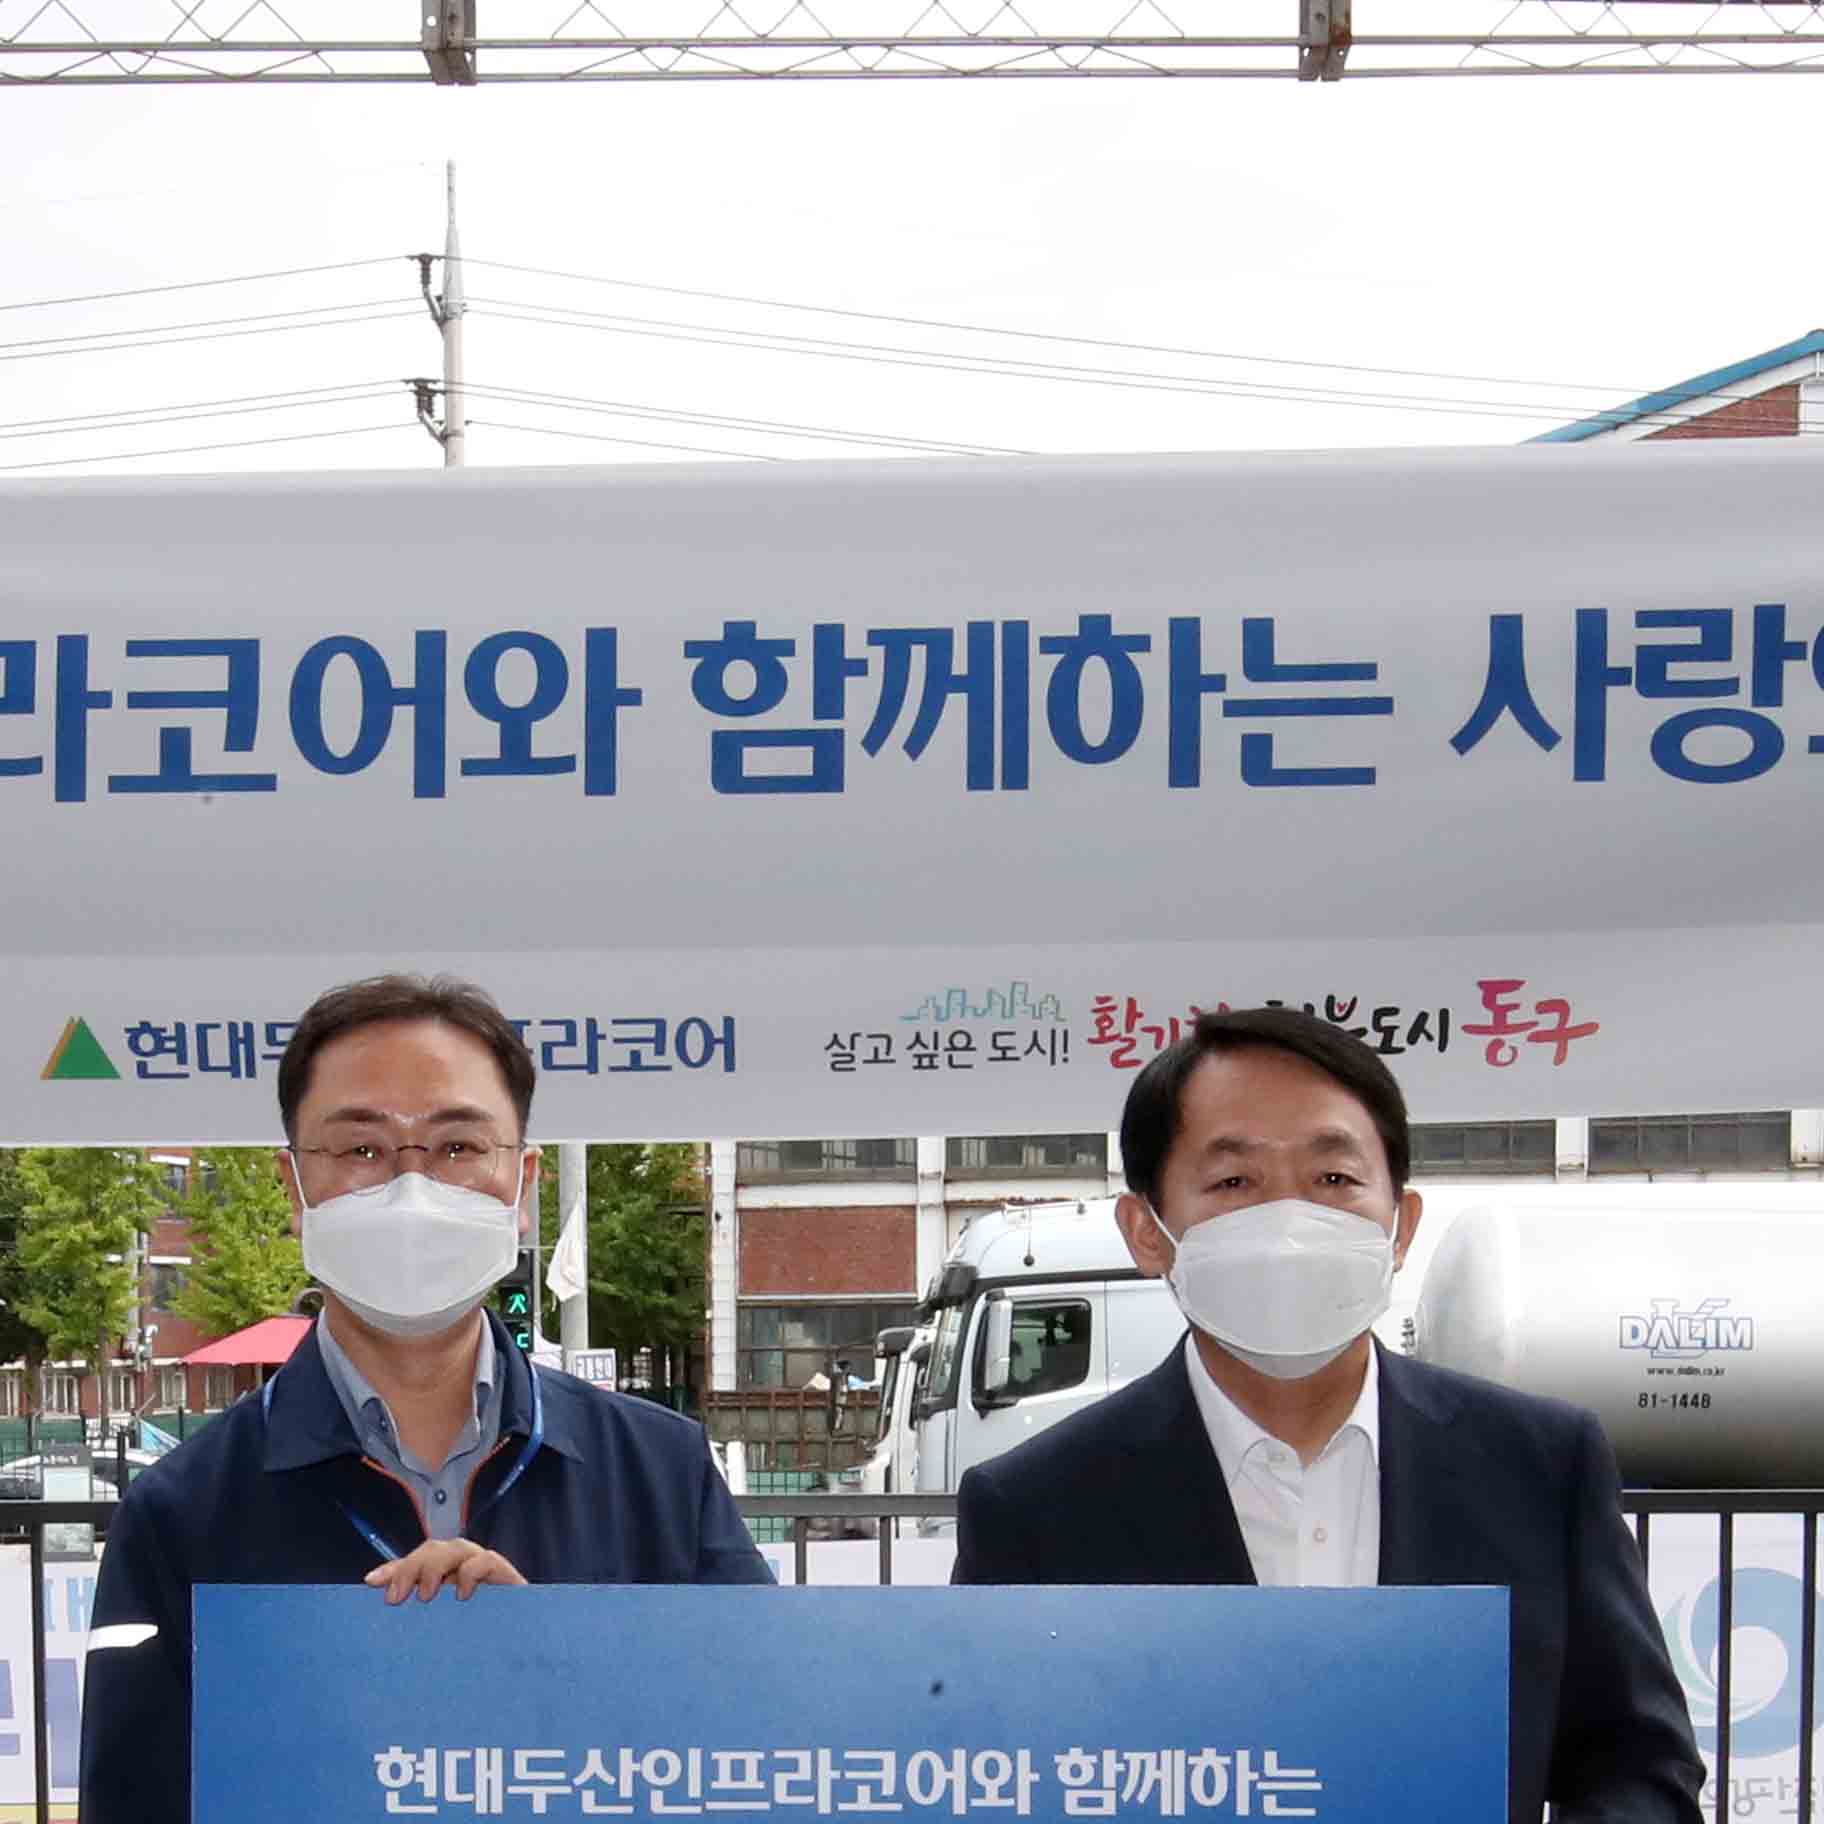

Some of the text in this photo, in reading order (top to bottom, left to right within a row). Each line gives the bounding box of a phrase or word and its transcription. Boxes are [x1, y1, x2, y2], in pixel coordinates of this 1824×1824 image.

[687, 617, 1393, 796] 함께하는
[124, 1017, 736, 1081] 현대라코어
[824, 1028, 1070, 1069] 살고 싶은 도시!
[1460, 978, 1600, 1067] 동구
[1619, 1316, 1753, 1350] DALIM
[375, 1747, 1323, 1817] 현대두산인프라코어와 함께하는
